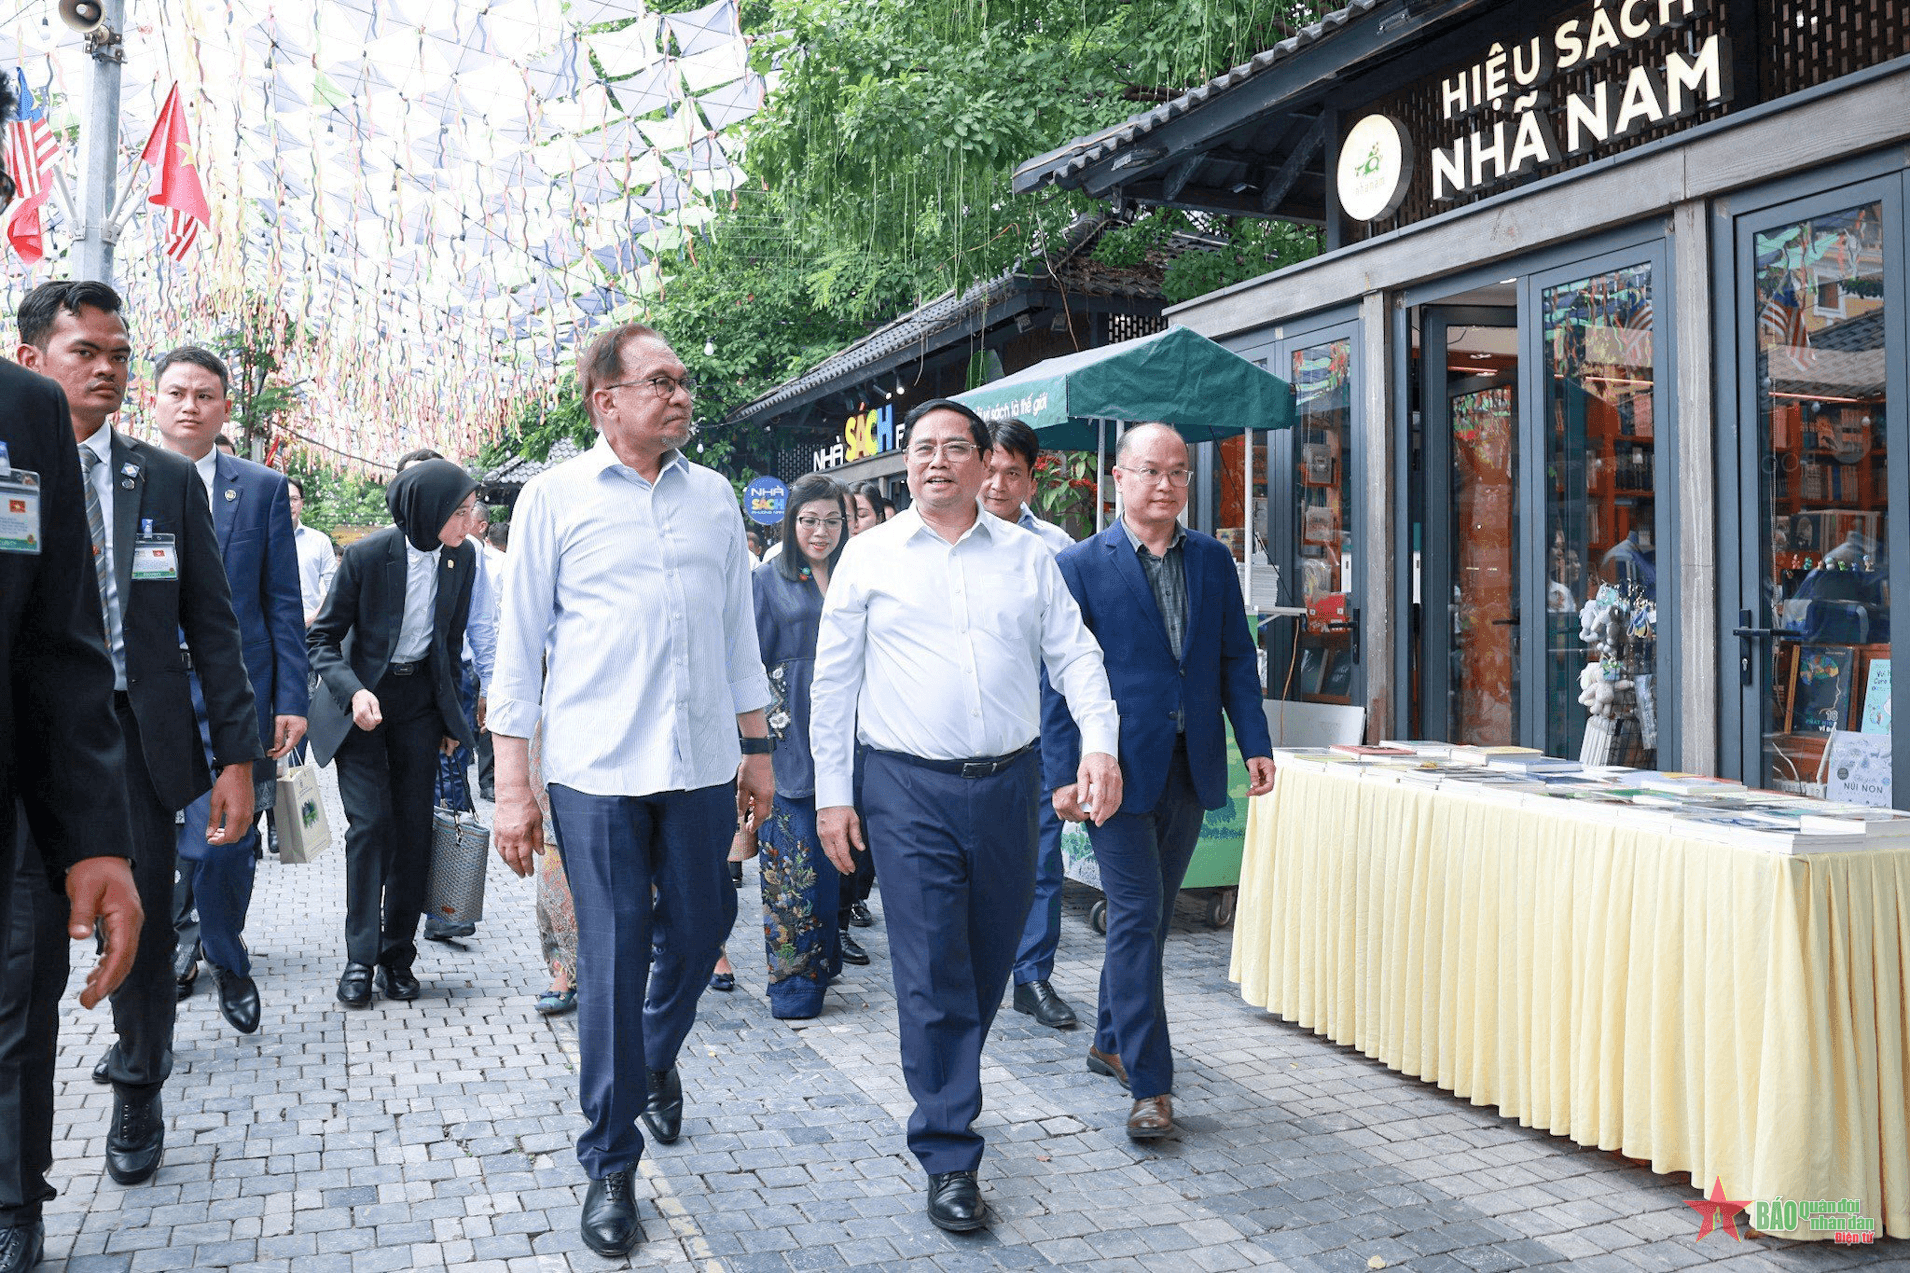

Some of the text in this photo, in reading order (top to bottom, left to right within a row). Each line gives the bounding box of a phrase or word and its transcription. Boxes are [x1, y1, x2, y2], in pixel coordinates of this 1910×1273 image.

[1441, 36, 1541, 120] HIỆU
[1431, 34, 1721, 200] NHÃ NAM
[991, 402, 1010, 420] sách
[1011, 399, 1019, 418] là
[813, 435, 845, 472] NHÀ
[845, 402, 894, 462] SÁCH
[751, 485, 785, 497] NHÀ
[751, 497, 785, 510] SÁCH
[1825, 709, 1839, 721] 18
[1843, 781, 1883, 794] NÚI NON
